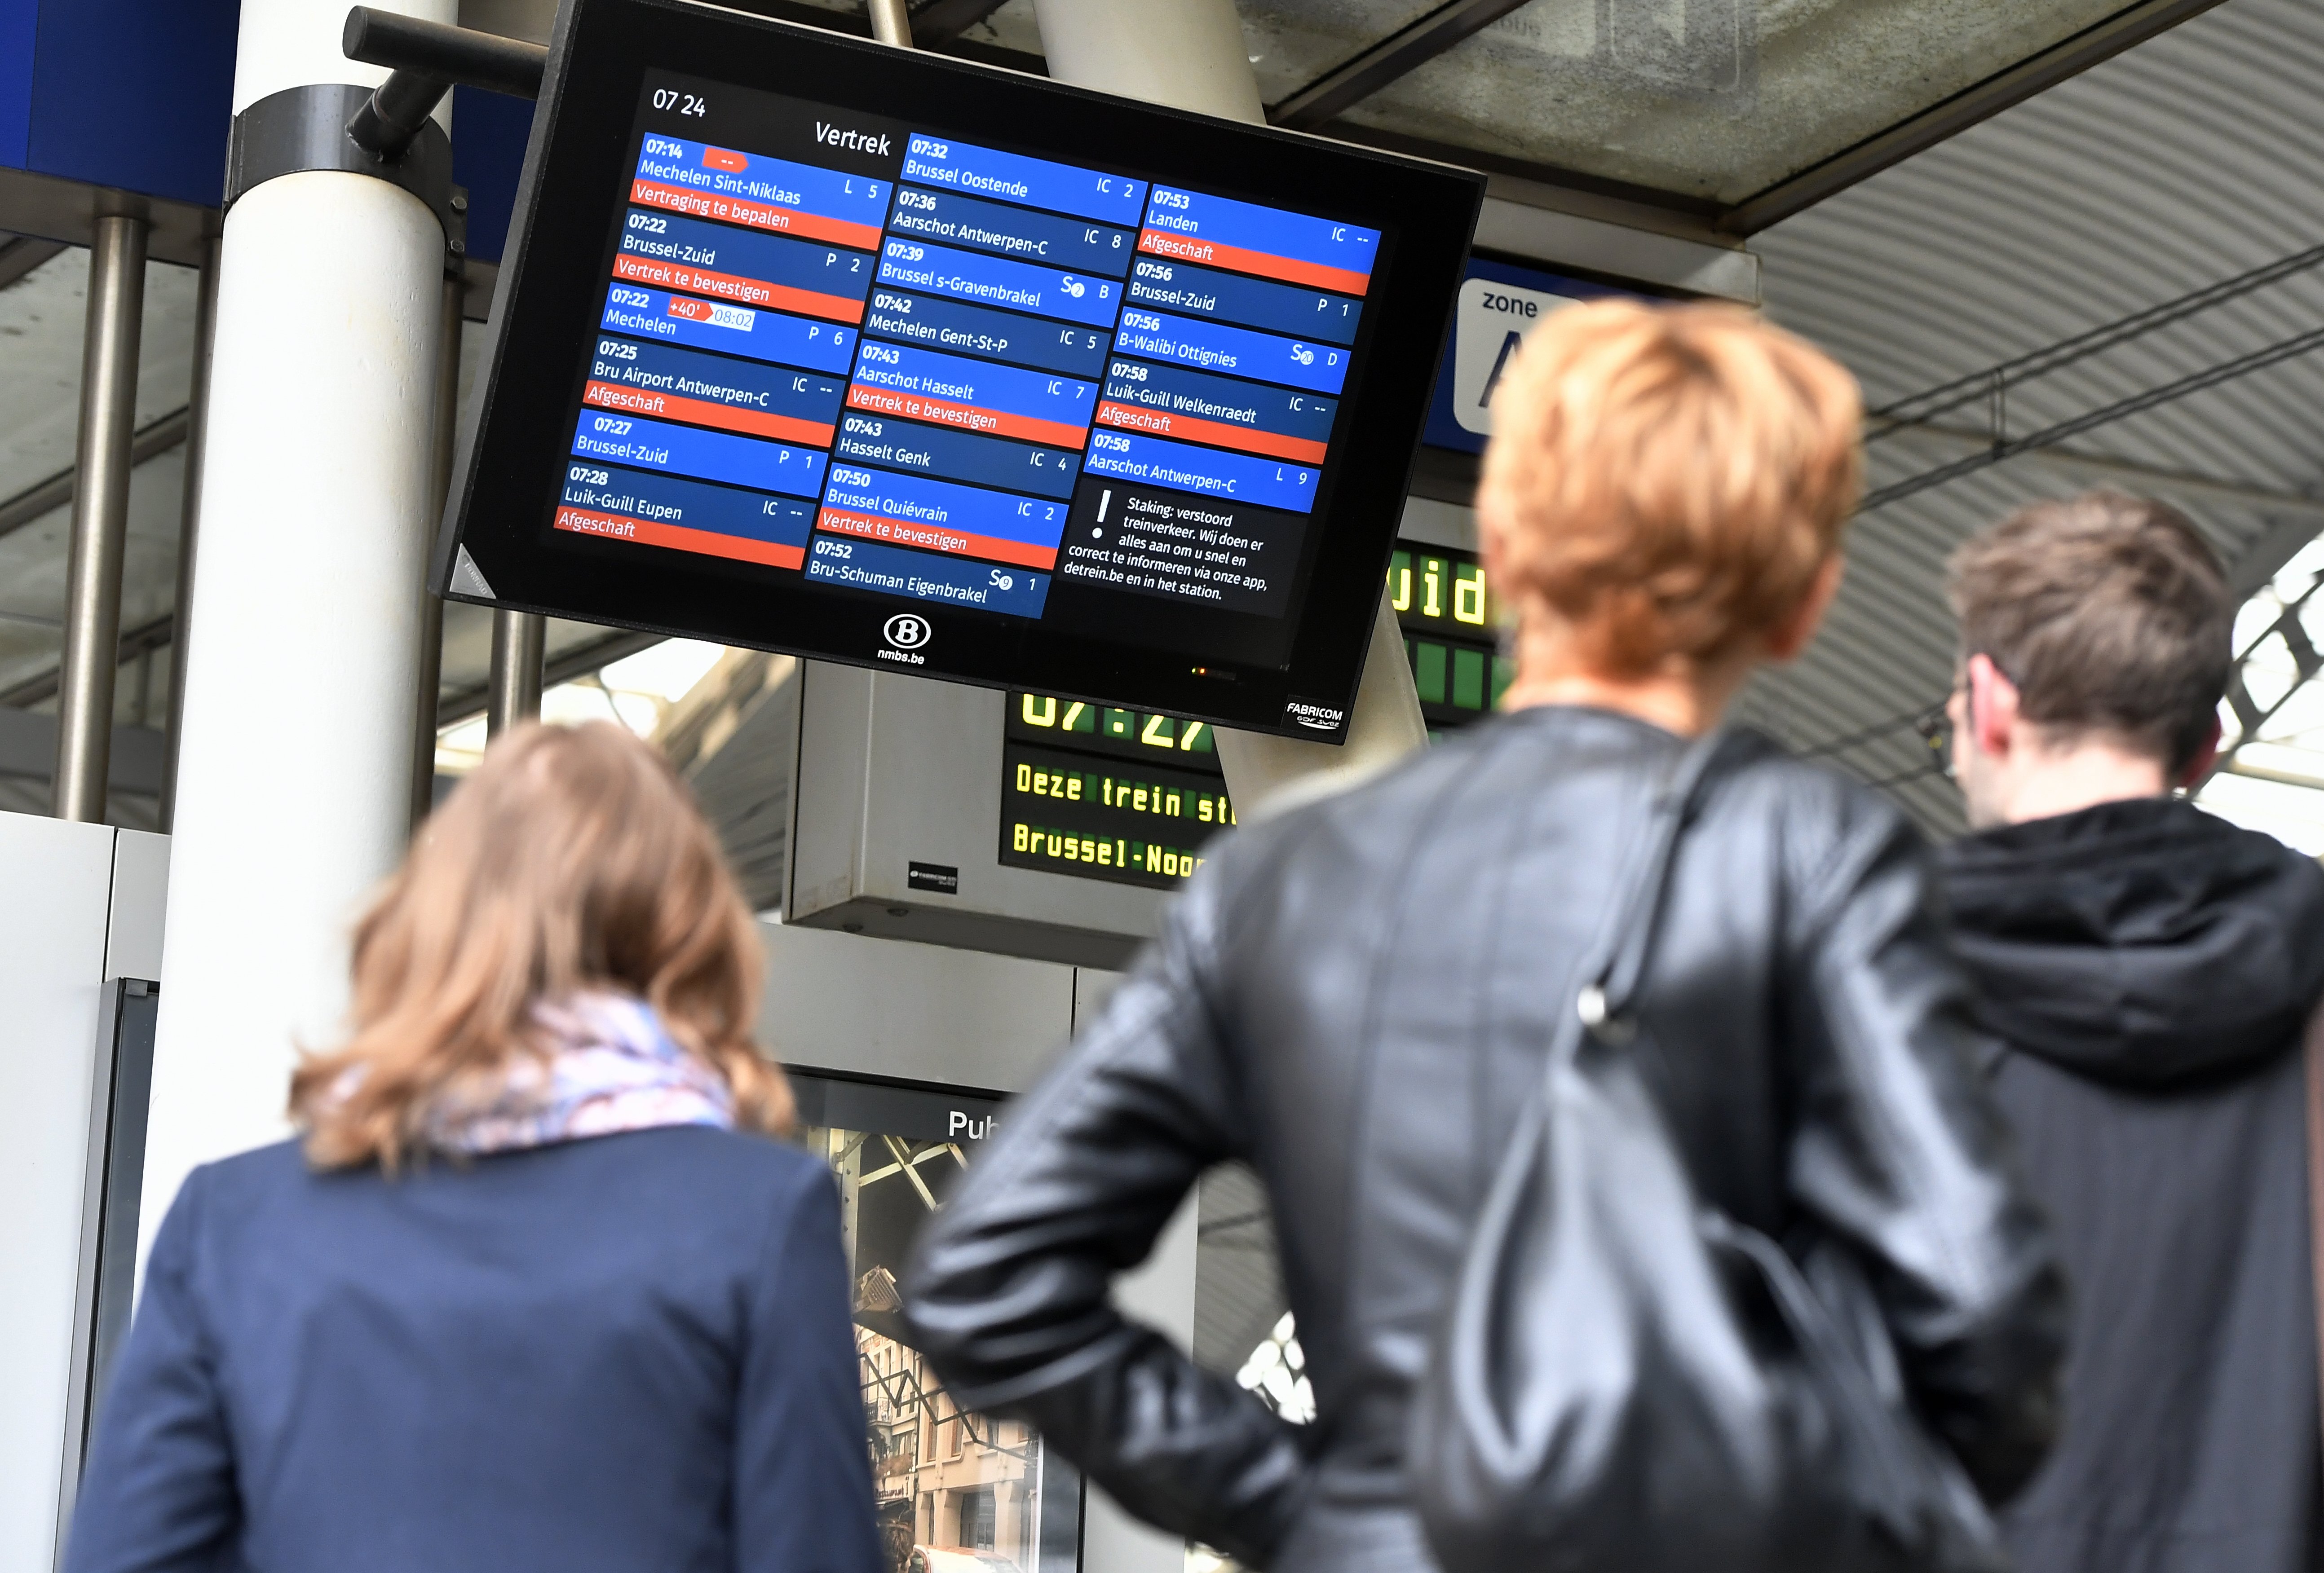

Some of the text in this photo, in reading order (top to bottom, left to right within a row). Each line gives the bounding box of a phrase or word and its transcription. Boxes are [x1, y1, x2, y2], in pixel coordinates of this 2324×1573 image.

[653, 88, 706, 118] 07 24
[816, 121, 891, 156] Vertrek
[640, 159, 801, 205] Mechelen Sint-Niklaas
[646, 139, 683, 159] 07:14
[844, 179, 853, 194] L
[868, 184, 878, 199] 5
[906, 159, 1028, 198] Brussel Oostende
[911, 139, 1134, 198] 07:32 IC 2
[636, 184, 789, 228] Vertraging te bepalen
[899, 191, 1122, 249] 07:36 IC 8
[1148, 209, 1198, 233] Landen
[1153, 190, 1190, 209] 07:53
[1331, 226, 1346, 242] IC
[623, 234, 716, 265] Brussel-Zuid
[628, 214, 860, 273] 07:22 P 2
[892, 211, 1048, 255] Aarschot Antwerpen-C
[1142, 234, 1214, 261] Afgeschaft
[619, 259, 770, 302] Vertrek te bevestigen
[881, 262, 1041, 307] Brussel s-Gravenbrakel
[887, 242, 924, 261] 07:39
[1099, 284, 1109, 299] B
[1136, 262, 1349, 317] 07:56 P 1
[1131, 281, 1216, 311] Brussel-Zuid
[1482, 291, 1538, 318] zone
[605, 308, 676, 335] Mechelen
[611, 288, 843, 346] 07:22 +40' 08:02 P 6
[869, 313, 1008, 352] Mechelen Gent-St-P
[874, 294, 1097, 349] 07:42 IC 5
[1118, 332, 1237, 368] B-Walibi Ottignies
[1124, 312, 1160, 331] 07:56
[1327, 352, 1338, 366] D
[594, 361, 770, 407] Bru Airport Antwerpen-C
[599, 340, 638, 360] 07:25
[792, 376, 808, 392] IC
[856, 365, 974, 400] Aarschot Hasselt
[862, 345, 1085, 399] 07:43 IC 7
[1111, 362, 1148, 382] 07:58
[1289, 396, 1303, 411] IC
[587, 386, 665, 413] Afgeschaft
[853, 388, 997, 429] Vertrek te bevestigen
[1100, 406, 1171, 432] Afgeschaft
[1106, 382, 1257, 423] Luik-Guill Welkenraedt
[577, 435, 669, 464] Brussel-Zuid
[594, 417, 813, 469] 07:27 P 1
[839, 437, 931, 467] Hasselt Genk
[844, 418, 1066, 471] 07:43 IC 4
[1094, 434, 1308, 485] 07:58 L 9
[570, 467, 609, 486] 07:28
[763, 500, 778, 516] IC
[1088, 453, 1237, 493] Aarschot Antwerpen-C
[565, 486, 682, 520] Luik-Guill Eupen
[827, 488, 948, 522] Brussel Quiévrain
[832, 468, 1054, 521] 07:50 IC 2
[1127, 497, 1233, 527] Staking: verstoord
[558, 511, 636, 538] Afgeschaft
[823, 511, 967, 551] Vertrek te bevestigen
[1123, 516, 1264, 551] treinverkeer. Wij doen er
[815, 540, 853, 559] 07:52
[1029, 578, 1036, 591] 1
[1068, 545, 1267, 592] correct te informeren via onze app,
[1118, 533, 1246, 567] alles aan om u snel en
[810, 560, 988, 604] Bru-Schuman Eigenbrakel
[1064, 561, 1222, 600] detrein.be en in het station.
[877, 649, 925, 665] nmbs.be
[1286, 702, 1343, 721] FABRICOM
[1016, 763, 1237, 825] Deze trein st
